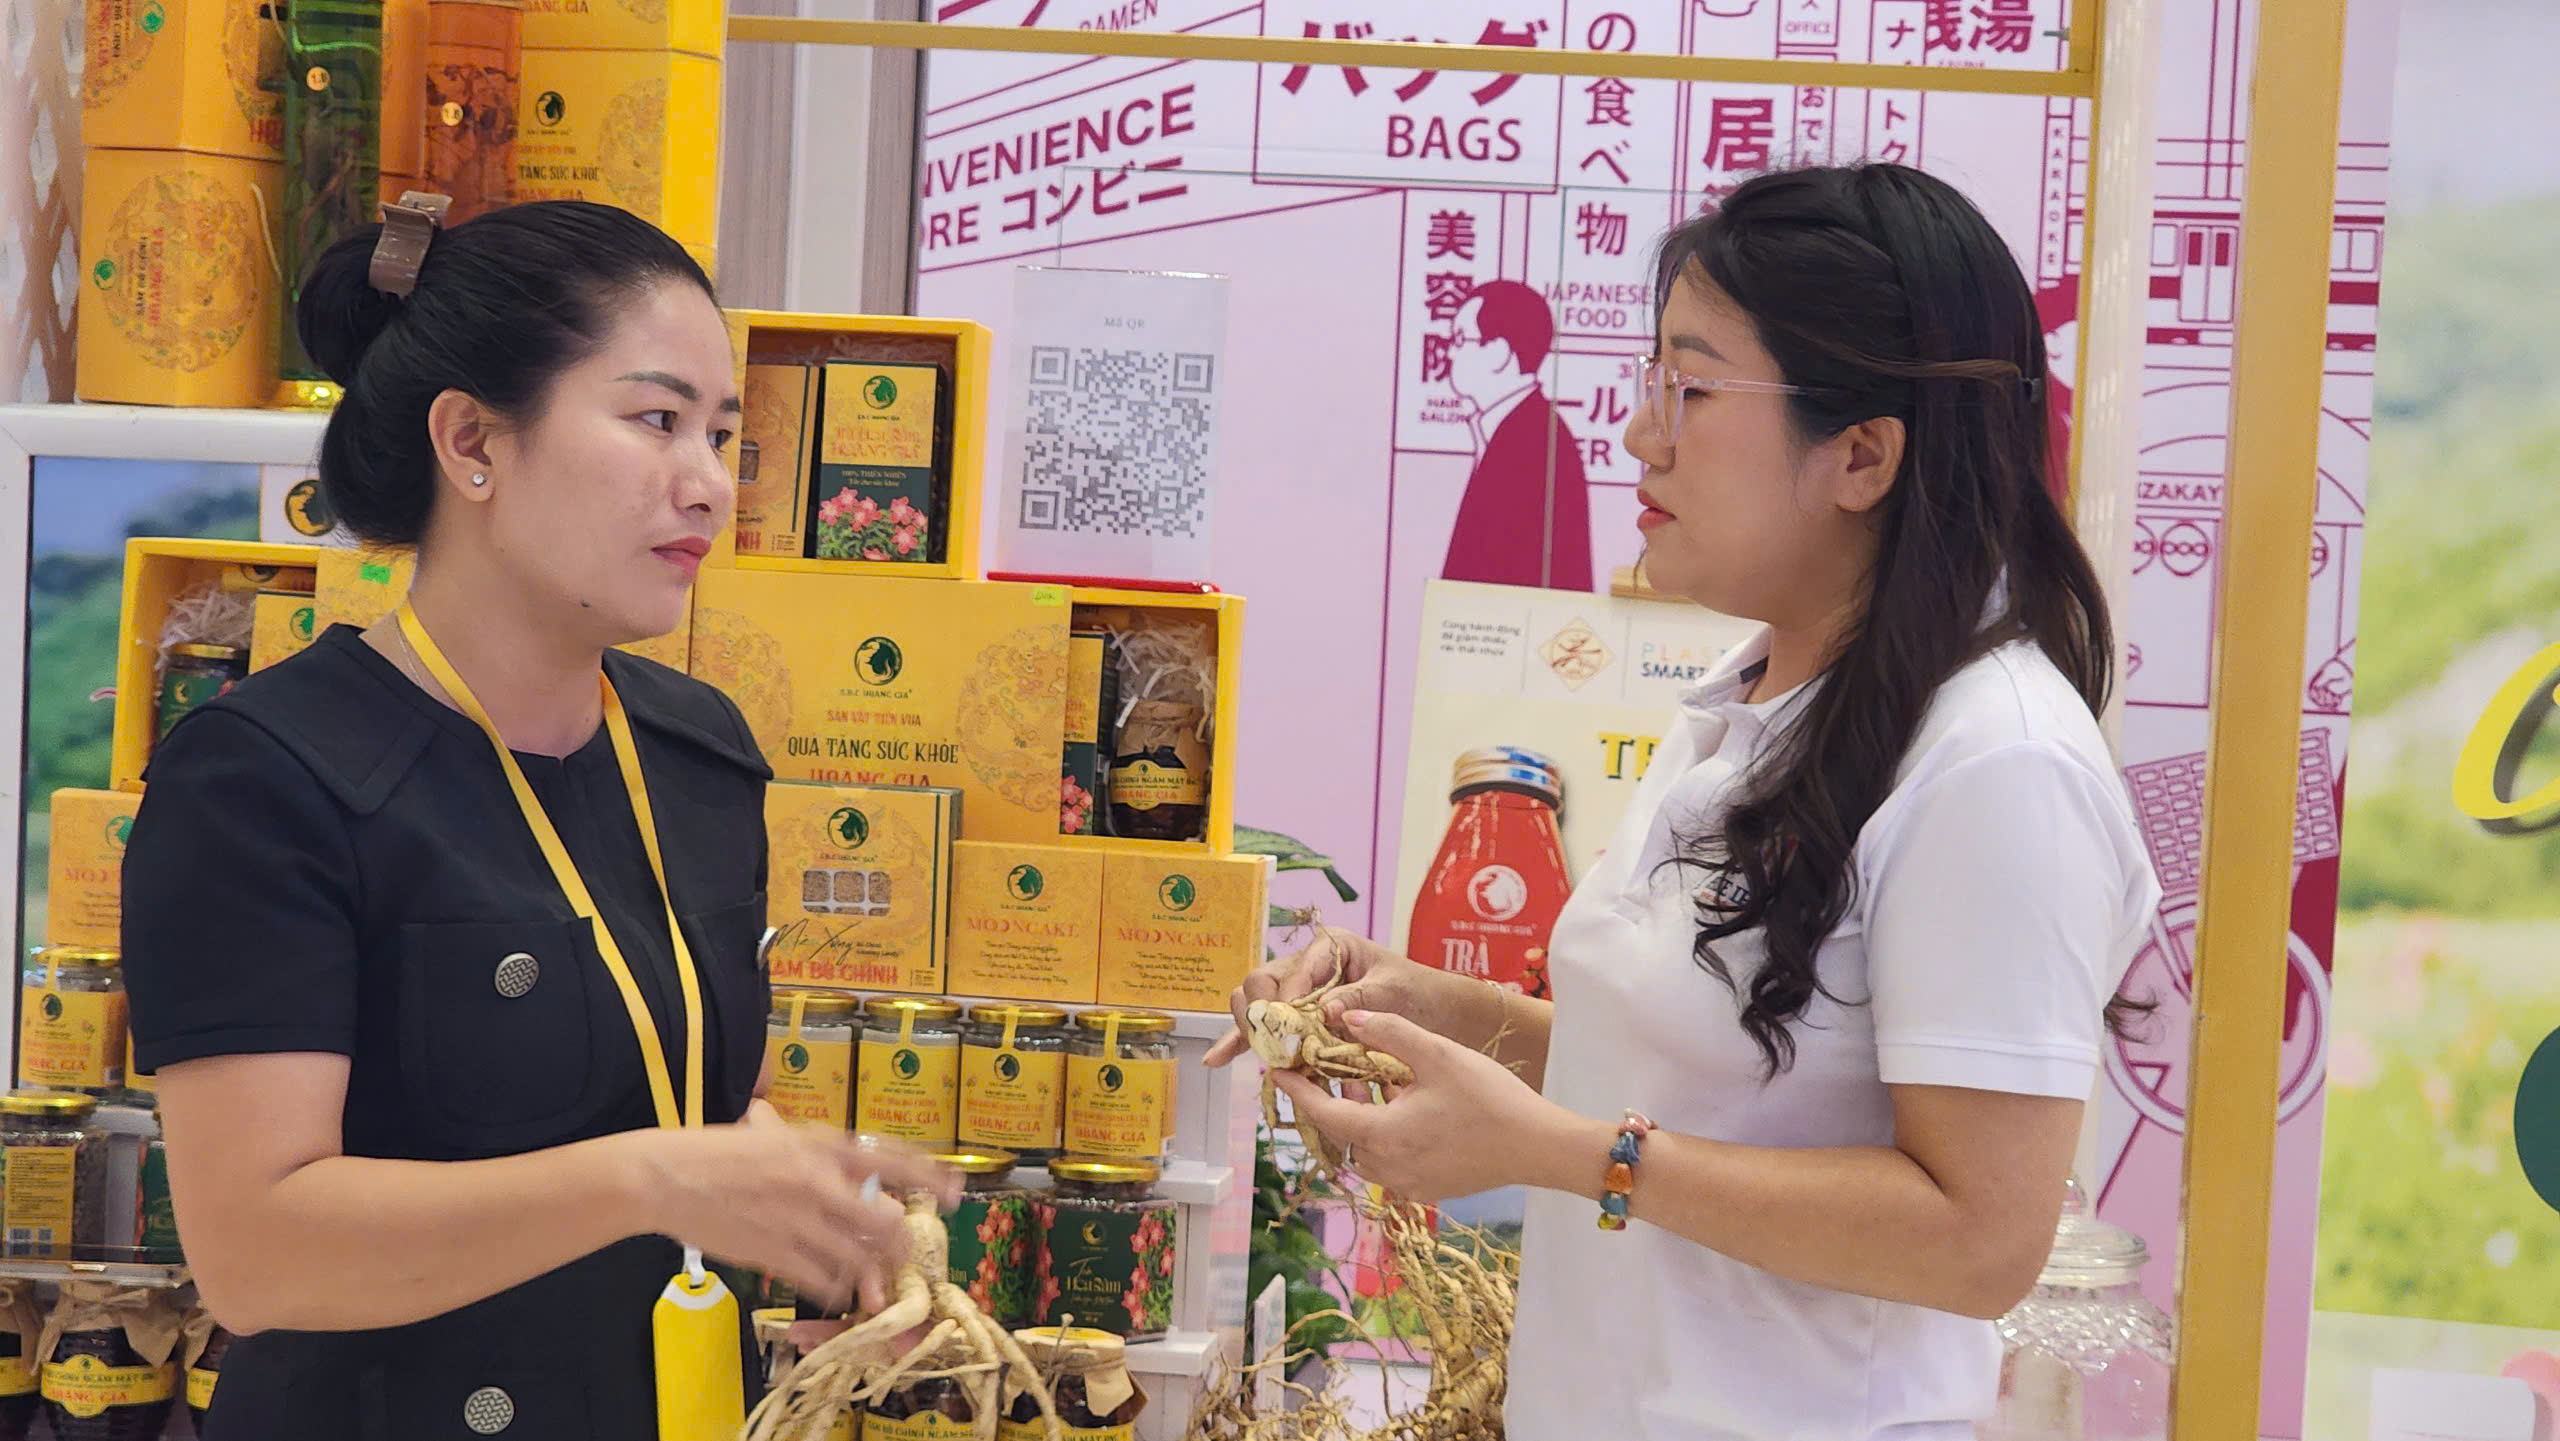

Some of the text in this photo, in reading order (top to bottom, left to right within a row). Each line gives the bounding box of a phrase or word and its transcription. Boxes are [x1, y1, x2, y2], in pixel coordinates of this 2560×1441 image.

[1785, 24, 1831, 35] OFFICE
[1386, 114, 1521, 162] BAGS
[920, 156, 1189, 250] RE コンビニ
[1545, 282, 1651, 305] JAPANESE
[1564, 307, 1628, 328] FOOD
[2137, 480, 2220, 501] IZAKAY
[1641, 642, 1728, 662] PLAS
[967, 917, 1079, 937] MOONCAKE
[1119, 927, 1232, 948] MOONCAKE
[1441, 935, 1491, 977] TRÀ
